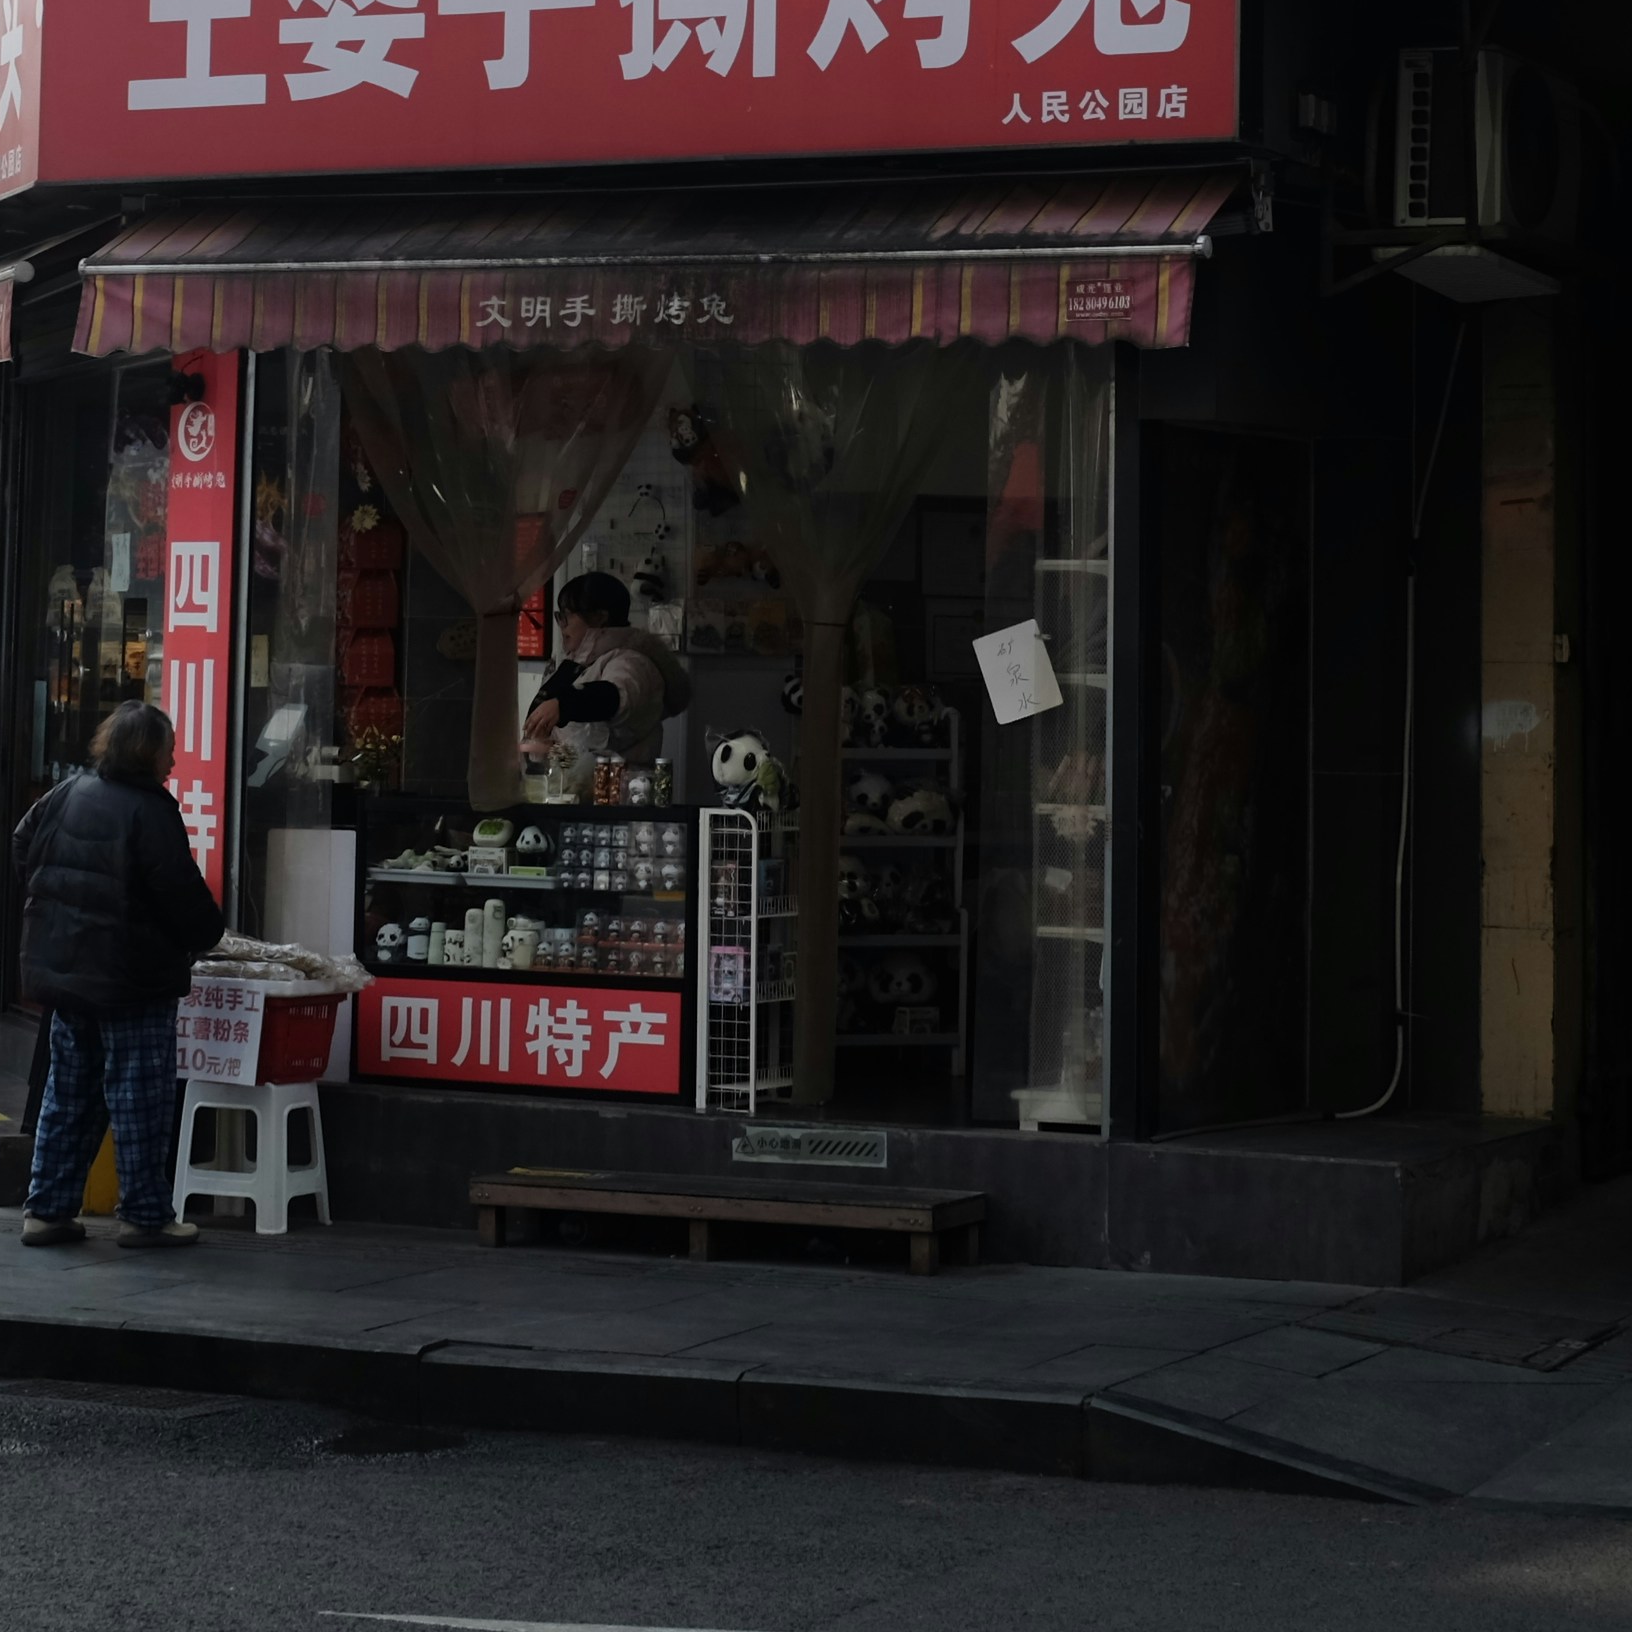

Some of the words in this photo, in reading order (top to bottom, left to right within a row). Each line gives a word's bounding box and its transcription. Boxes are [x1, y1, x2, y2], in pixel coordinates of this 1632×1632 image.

[1001, 84, 1189, 126] 人民公园店
[475, 292, 735, 329] 文明手撕烤兔
[996, 637, 1041, 713] 矿泉水
[378, 994, 670, 1082] 四川特产
